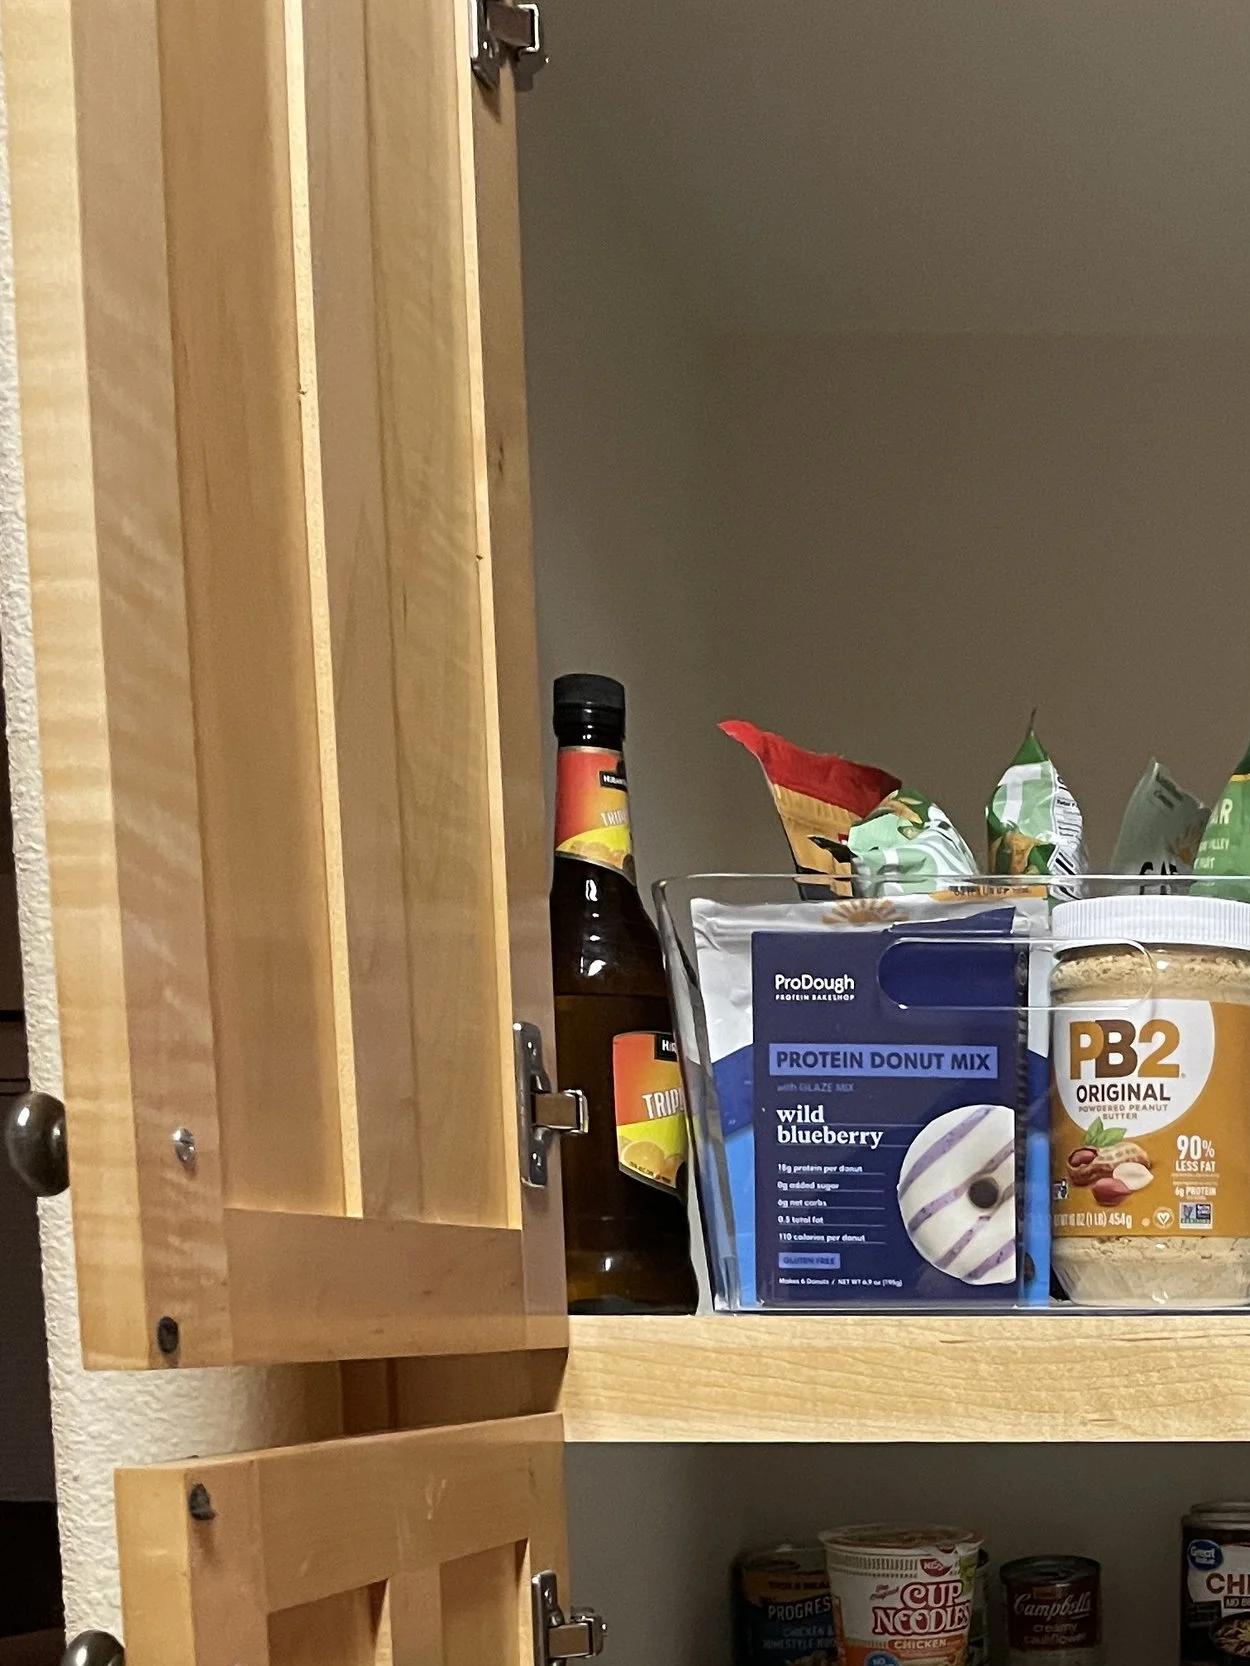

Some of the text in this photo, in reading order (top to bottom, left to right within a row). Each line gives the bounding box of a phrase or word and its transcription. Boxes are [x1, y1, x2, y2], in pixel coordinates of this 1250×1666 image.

[775, 974, 855, 993] ProDough
[1070, 1019, 1180, 1080] PB2
[777, 1051, 990, 1071] PROTEIN DONUT MIX
[777, 1083, 854, 1092] with GLAZE MIX
[1076, 1083, 1171, 1102] ORIGINAL
[776, 1105, 825, 1123] wild
[1078, 1104, 1169, 1113] POWDERED PEANUT
[777, 1126, 884, 1149] blueberry
[1176, 1134, 1215, 1161] 90%
[793, 1164, 862, 1173] protein per donut
[1175, 1160, 1215, 1173] LESS FAT
[789, 1181, 815, 1189] added
[817, 1183, 839, 1191] sugar
[1175, 1186, 1216, 1197] 6g PROTEIN
[1108, 1212, 1132, 1229] 454g
[826, 1235, 840, 1243] per
[1190, 1546, 1216, 1559] Great
[901, 1580, 964, 1609] CUP
[1014, 1591, 1092, 1622] Campbell's
[1225, 1598, 1240, 1607] NO
[872, 1601, 970, 1635] NOODLES
[1033, 1623, 1078, 1633] creamy
[894, 1639, 947, 1649] CHICKEN
